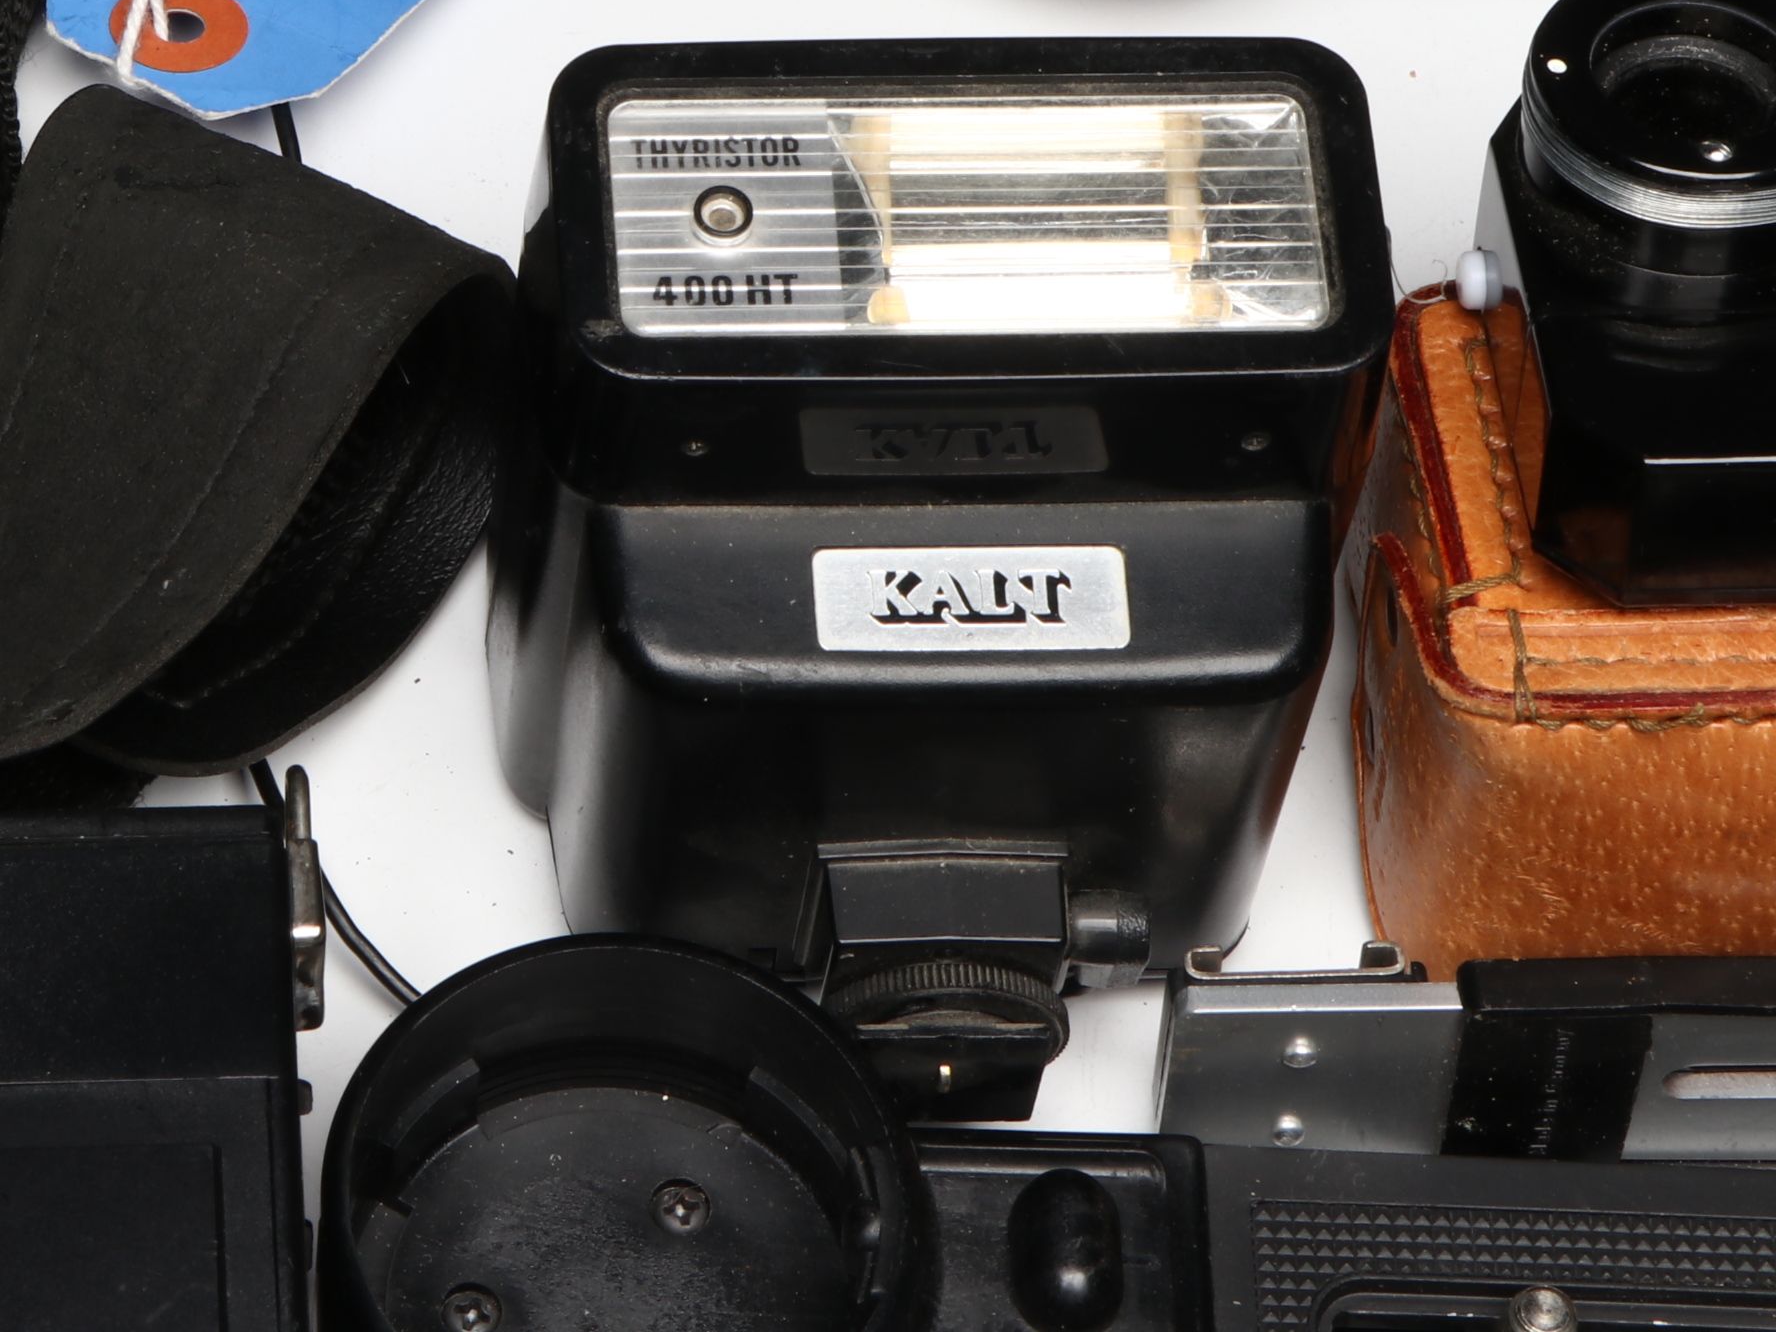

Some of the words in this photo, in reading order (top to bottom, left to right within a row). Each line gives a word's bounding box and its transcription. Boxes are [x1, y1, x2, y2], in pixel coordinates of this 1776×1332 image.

[629, 136, 801, 169] THYRISTOR
[652, 274, 735, 307] 400
[745, 272, 799, 305] HT
[868, 568, 1071, 625] KALT
